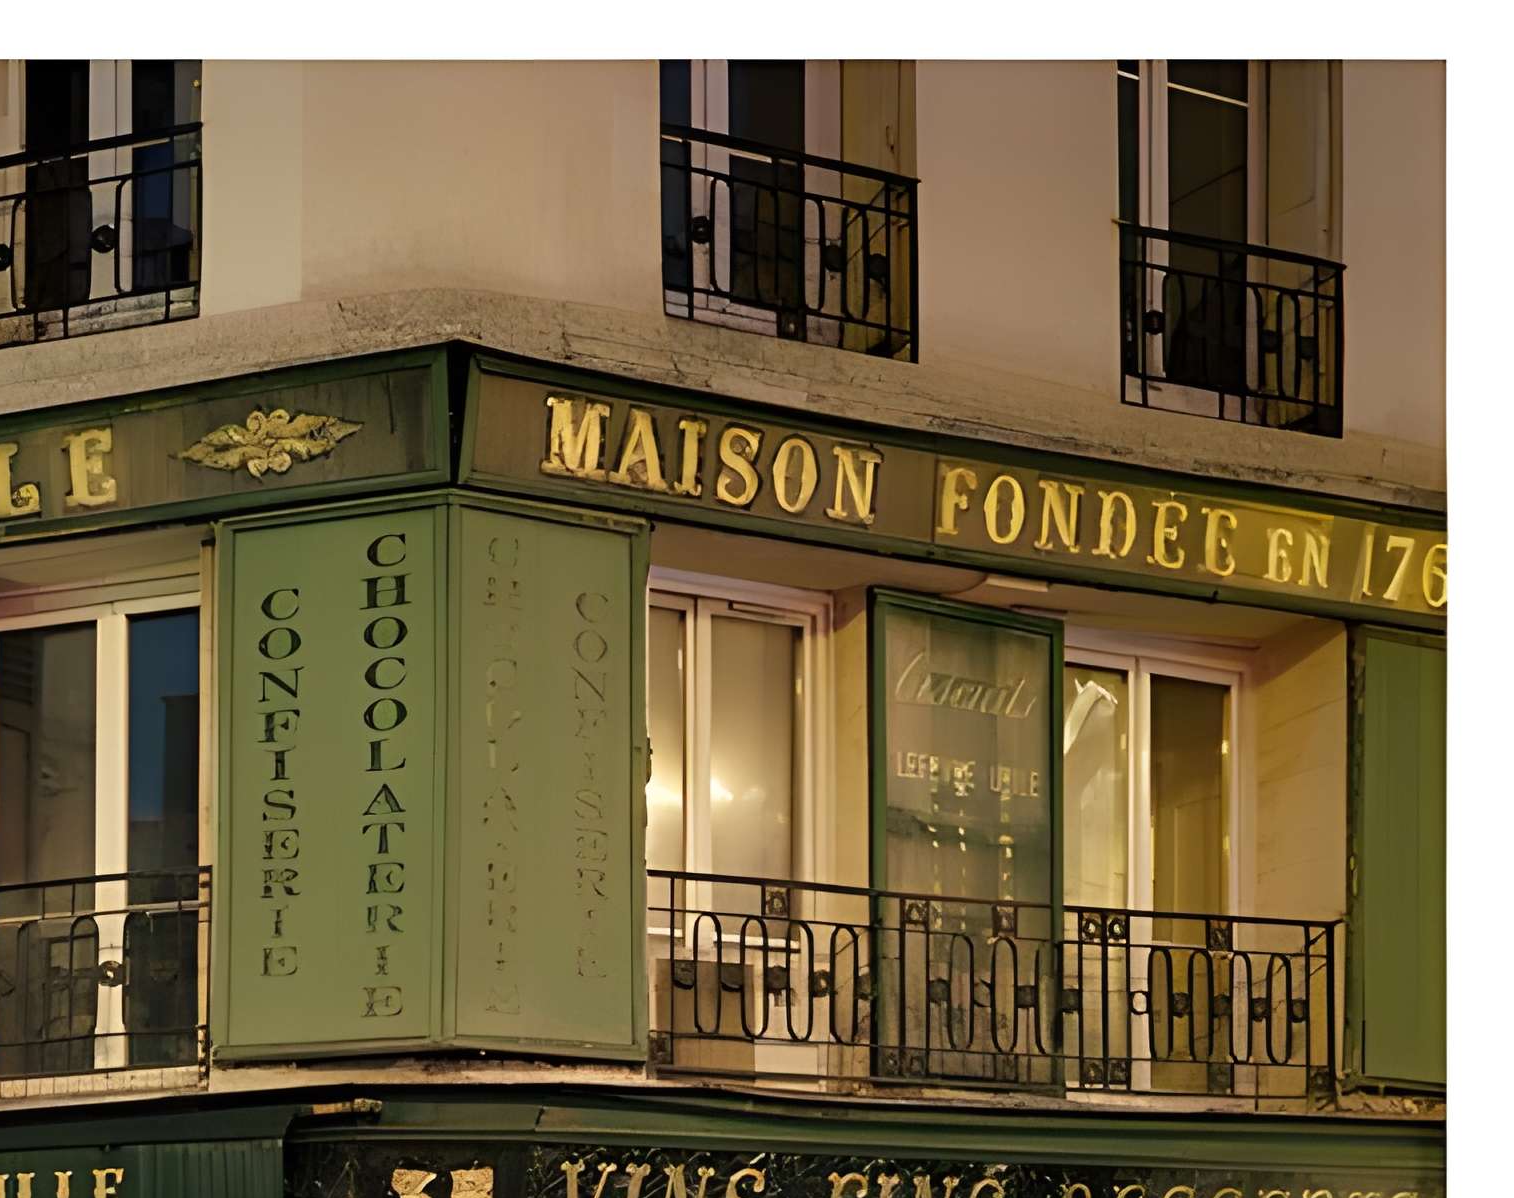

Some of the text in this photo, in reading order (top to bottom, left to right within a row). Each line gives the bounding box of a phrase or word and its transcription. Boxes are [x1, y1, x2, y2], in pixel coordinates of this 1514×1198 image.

[540, 396, 883, 528] MAISON
[258, 587, 304, 977] CONFISERIE
[359, 533, 411, 1017] CHOCOLATERIE
